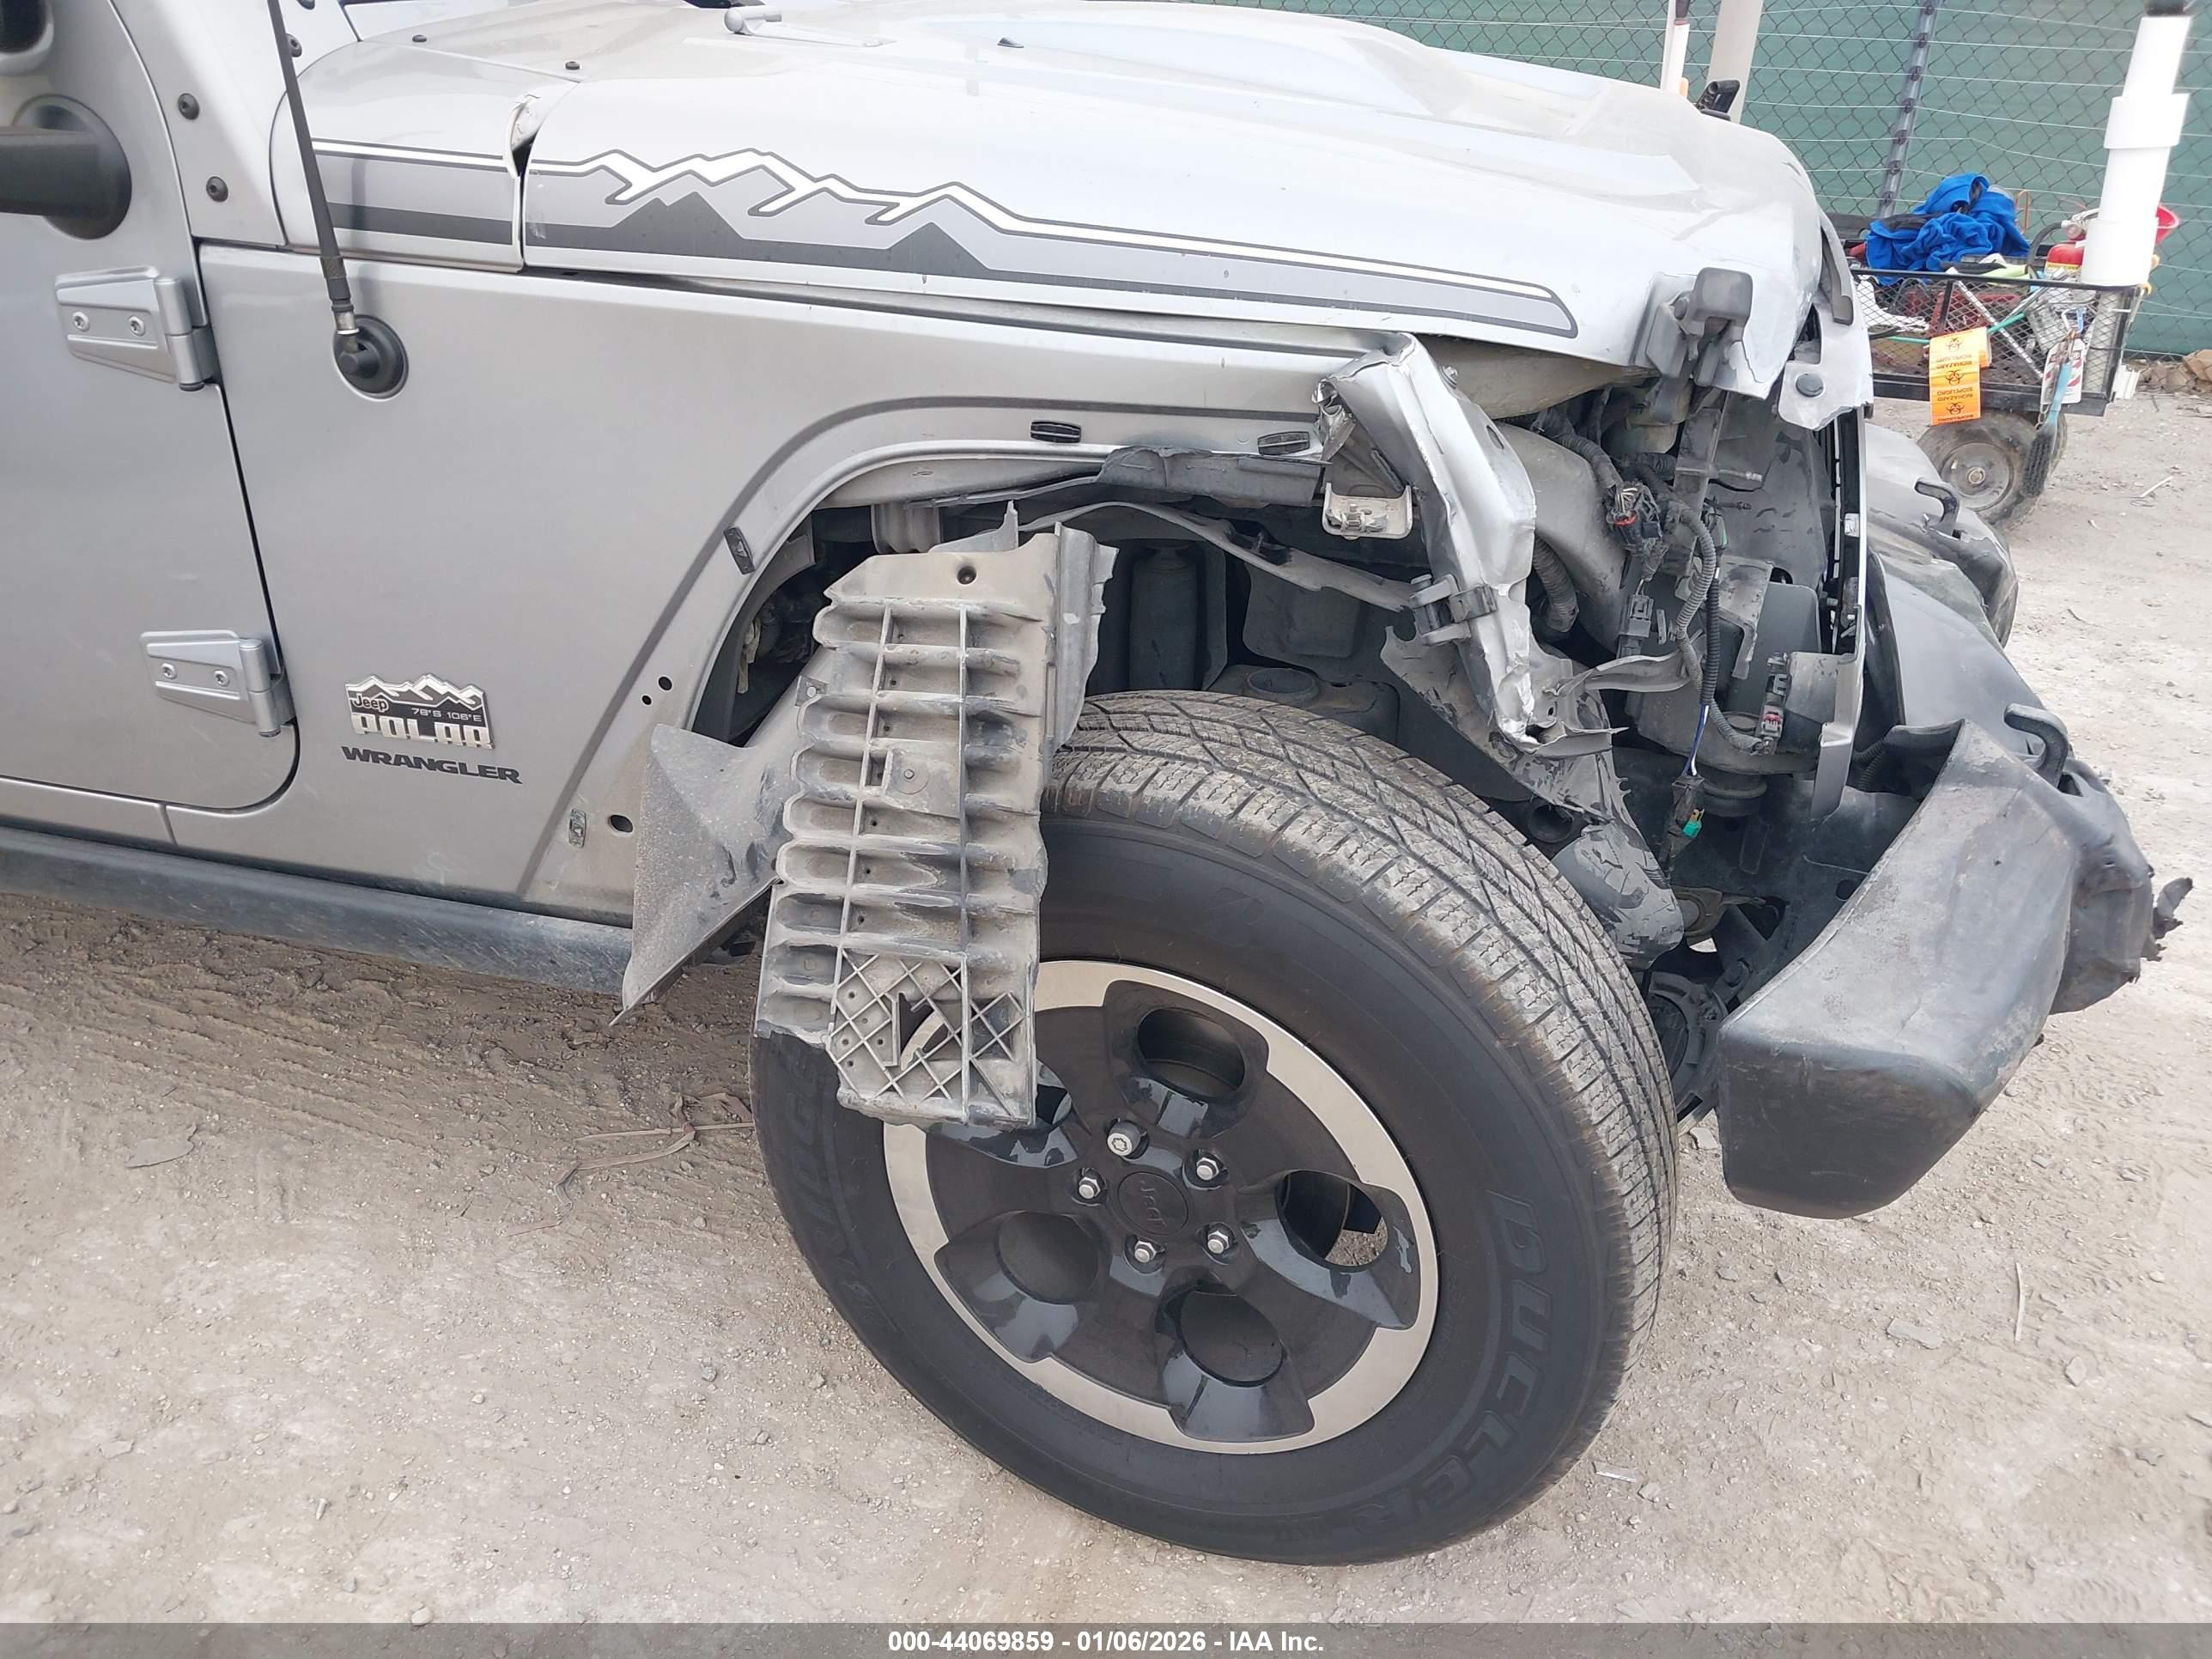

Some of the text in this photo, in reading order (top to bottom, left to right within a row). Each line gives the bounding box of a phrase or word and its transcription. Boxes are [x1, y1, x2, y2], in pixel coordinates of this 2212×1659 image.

[353, 693, 388, 712] Jeep
[351, 713, 494, 749] POLAR
[341, 745, 523, 784] WRANGLER
